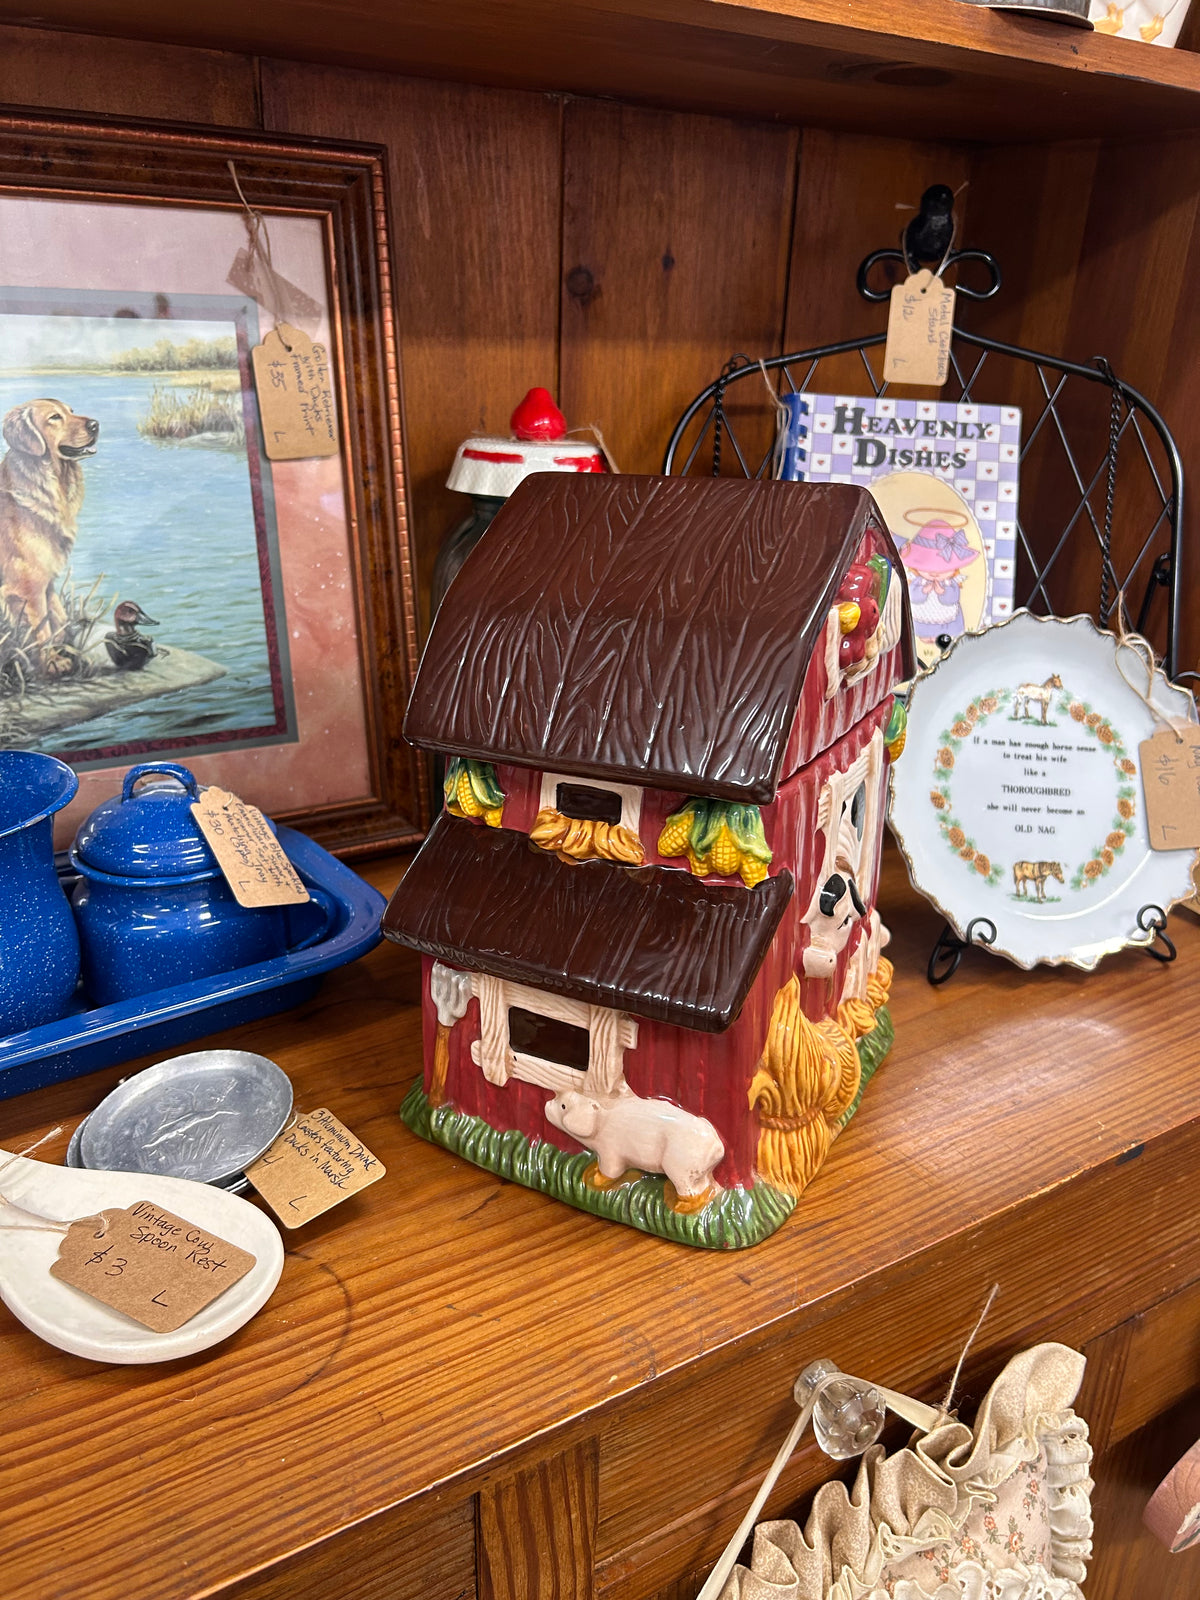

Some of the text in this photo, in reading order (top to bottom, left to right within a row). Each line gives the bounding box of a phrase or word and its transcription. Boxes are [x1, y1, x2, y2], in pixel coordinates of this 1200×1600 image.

[902, 294, 922, 320] $12
[267, 360, 287, 391] $35
[312, 344, 328, 383] Golden
[833, 406, 992, 440] HEAVENLY
[853, 438, 967, 469] DISHES
[973, 736, 980, 745] If
[1009, 739, 1021, 747] has
[1025, 742, 1049, 750] enough
[1053, 742, 1073, 751] horse
[1014, 753, 1032, 761] treat
[1036, 754, 1047, 762] his
[1051, 755, 1067, 763] wife
[1024, 768, 1038, 776] like
[1001, 784, 1071, 797] THOROUGHBRED
[987, 803, 999, 811] she
[1003, 804, 1018, 812] will
[1046, 807, 1073, 815] become
[203, 810, 224, 836] $30
[1014, 824, 1056, 835] OLD NAG
[269, 842, 285, 861] Blue
[283, 1133, 310, 1157] Ducks
[309, 1152, 320, 1164] in
[349, 1143, 377, 1172] Drink
[131, 1202, 182, 1237] Vintage
[129, 1225, 228, 1273] Spoon Rest
[151, 1289, 169, 1308] L
